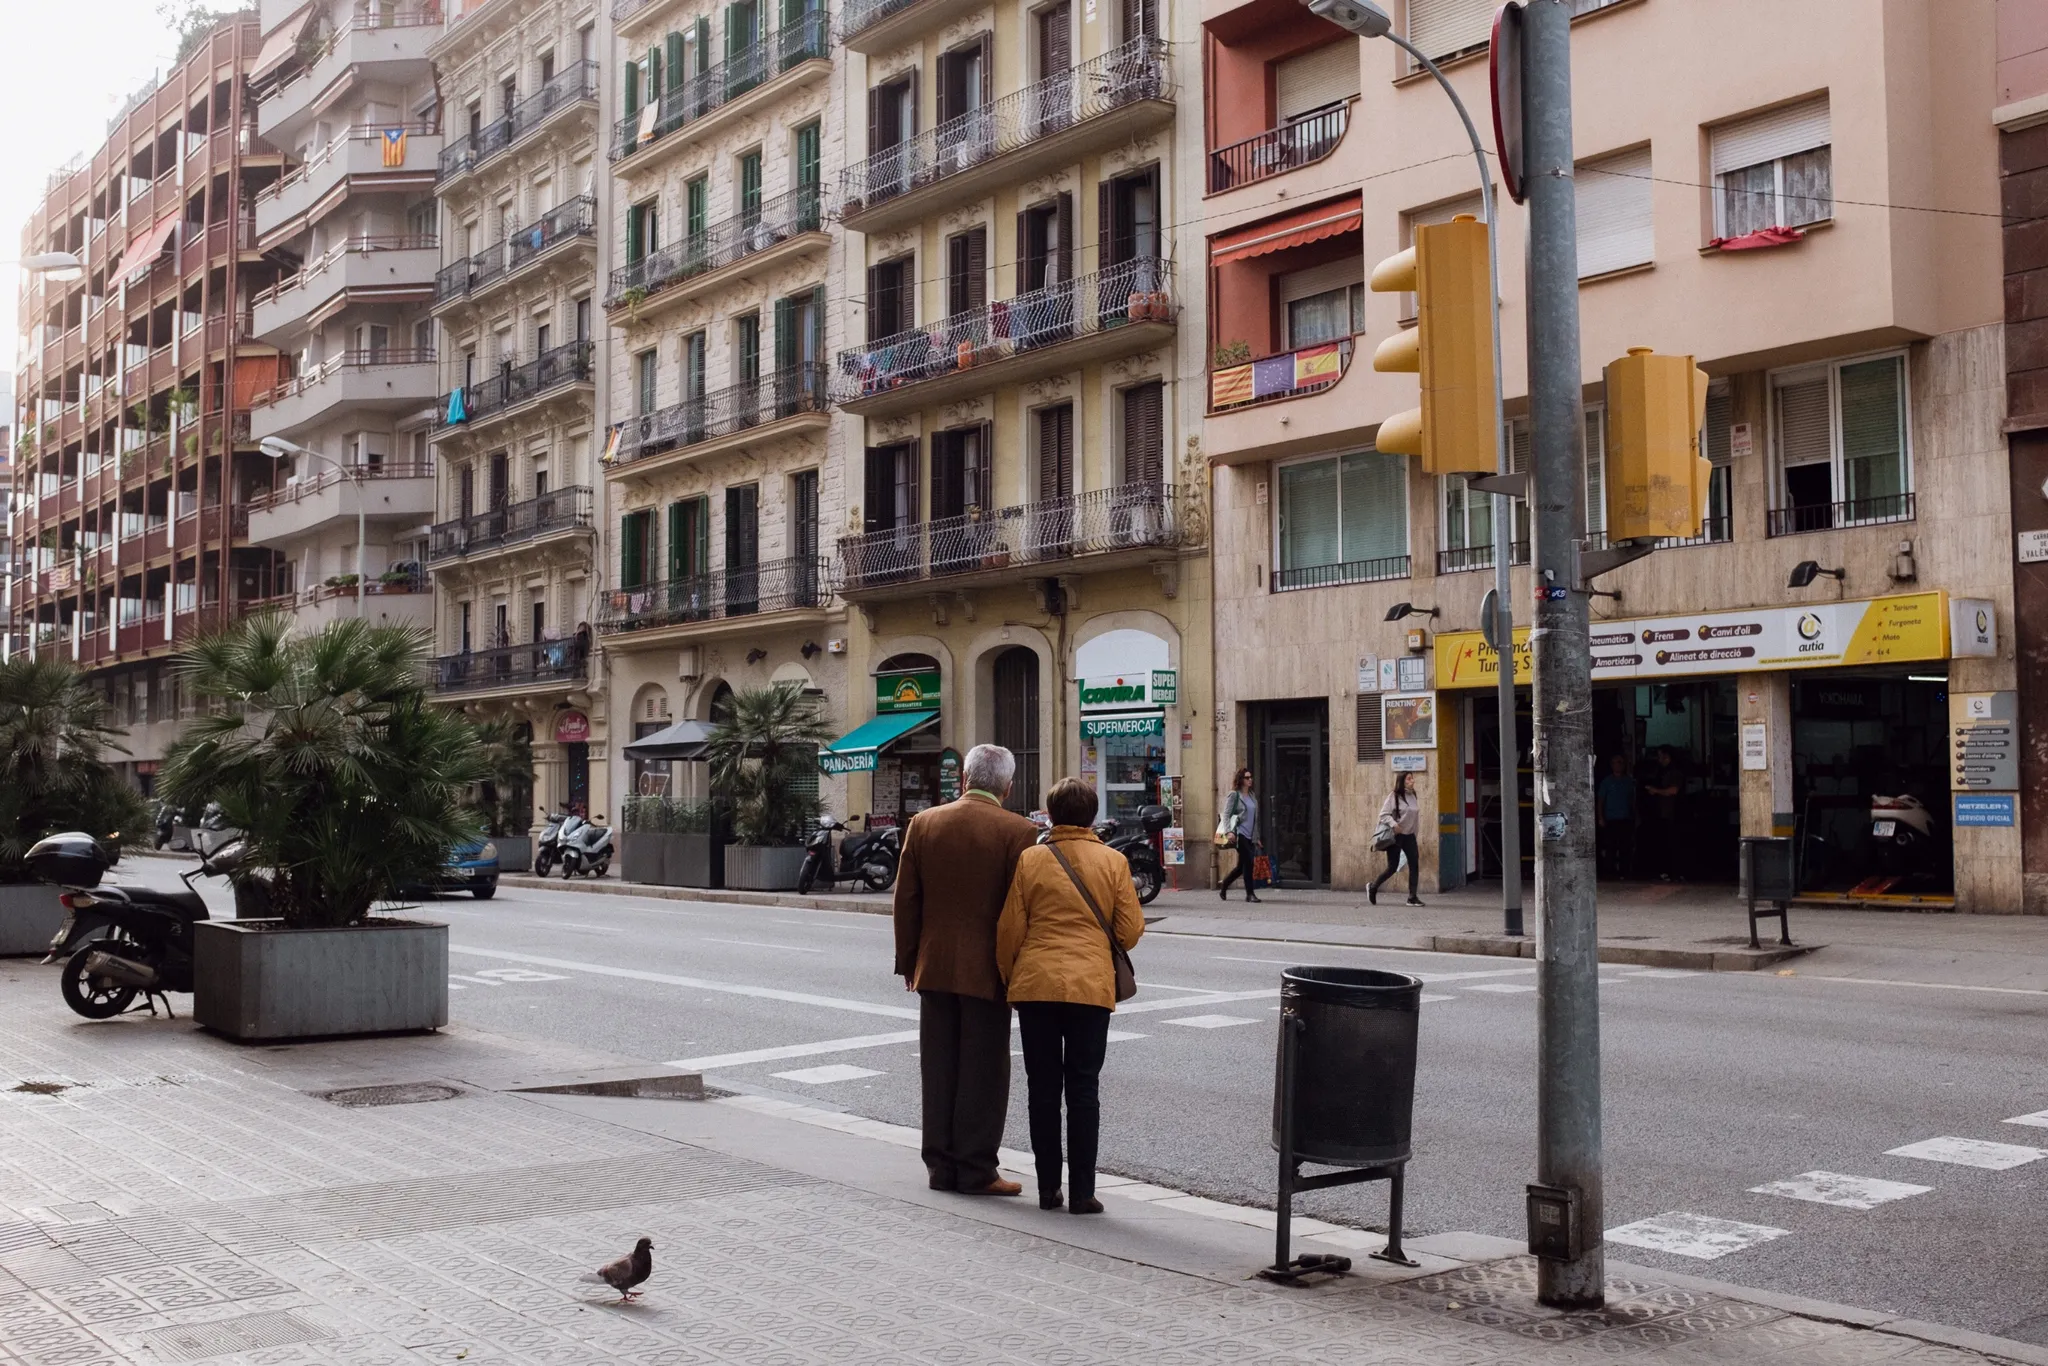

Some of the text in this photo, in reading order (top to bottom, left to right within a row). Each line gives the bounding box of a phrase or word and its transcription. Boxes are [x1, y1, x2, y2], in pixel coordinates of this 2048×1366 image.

[2033, 533, 2048, 541] CARR
[2026, 547, 2048, 558] VALÈN
[1888, 618, 1922, 628] Furgoneta
[1654, 632, 1675, 641] Frens
[1710, 625, 1751, 638] Canvi d'oli
[1882, 633, 1901, 641] Moto
[1589, 634, 1629, 645] Pneumàtics
[1798, 641, 1825, 652] autia
[1669, 647, 1742, 662] Alineat de direcció
[1478, 659, 1519, 675] Tung
[1595, 656, 1636, 667] Amortidors
[1152, 673, 1176, 688] SUPER
[1083, 679, 1146, 704] COVIRA
[1152, 688, 1176, 701] MERCAT
[1386, 700, 1417, 708] RENTING
[1087, 719, 1157, 735] SUPERMERCAT
[823, 751, 874, 772] PANADERÍA
[1958, 814, 2011, 822] SERVICIO OFICIAL
